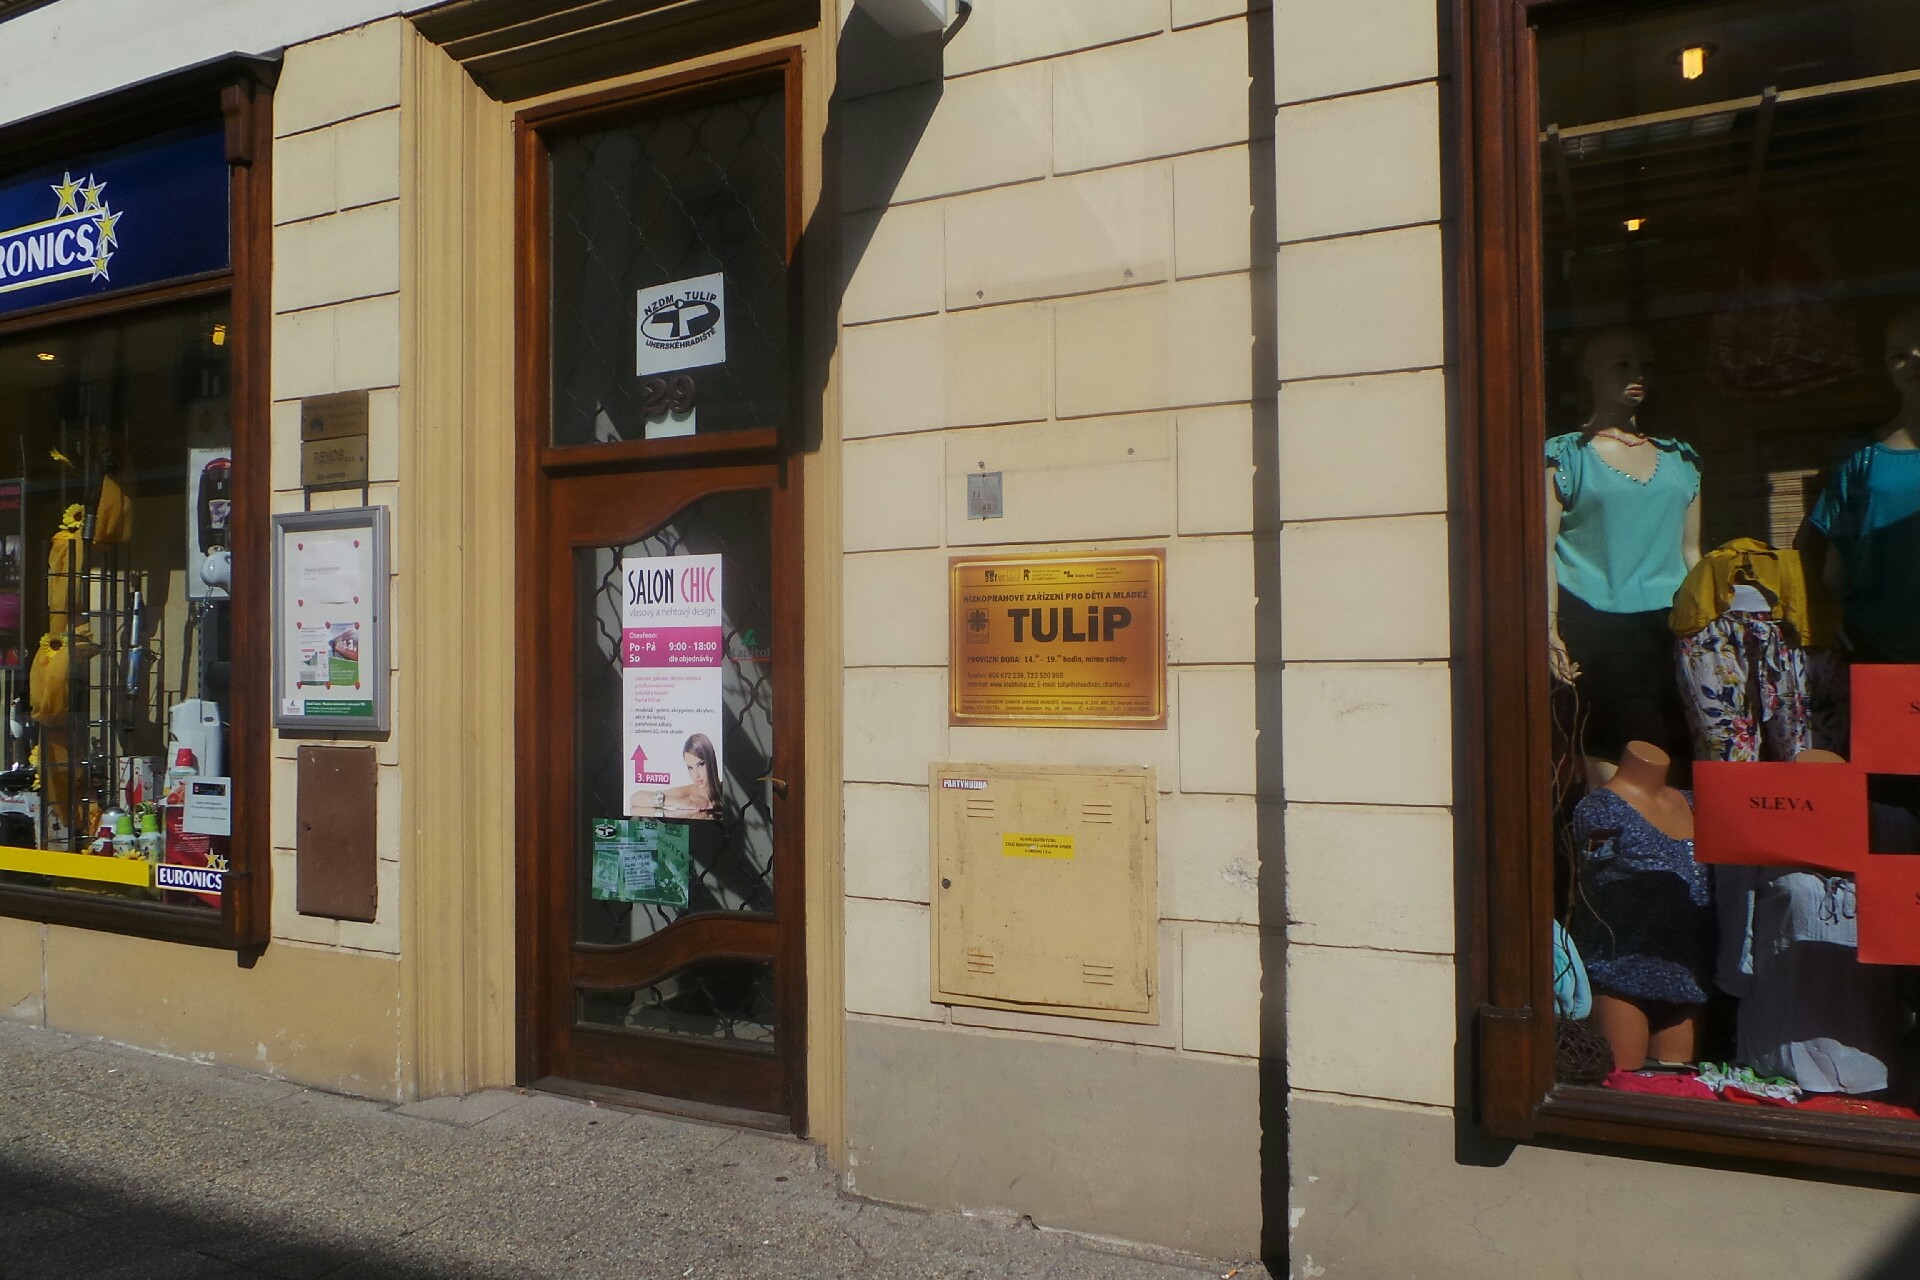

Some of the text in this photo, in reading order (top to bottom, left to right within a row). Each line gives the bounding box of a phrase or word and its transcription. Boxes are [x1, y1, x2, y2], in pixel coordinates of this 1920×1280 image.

[644, 291, 717, 316] NZDM TULIP
[628, 566, 715, 606] SALON CHIC
[963, 591, 1025, 603] NÍZKOPRAHOVÉ
[1026, 590, 1064, 602] ZAŘÍZENÍ
[1066, 592, 1083, 601] PRO
[1085, 589, 1104, 600] DĚTI
[1105, 591, 1111, 599] A
[629, 608, 654, 618] vlasový
[661, 607, 691, 617] nehtový
[692, 606, 716, 617] design
[629, 631, 658, 639] Otevřeno:
[629, 642, 640, 651] Po
[646, 641, 656, 651] Pá
[668, 642, 687, 651] 9:00
[693, 641, 717, 651] 18:00
[629, 653, 714, 664] So dle objednávky
[1063, 655, 1084, 664] hodin,
[637, 772, 670, 784] 3. PATRO
[943, 779, 988, 789] PARTYHUDBA
[1748, 796, 1815, 812] SLEVA
[159, 867, 222, 891] EURONICS
